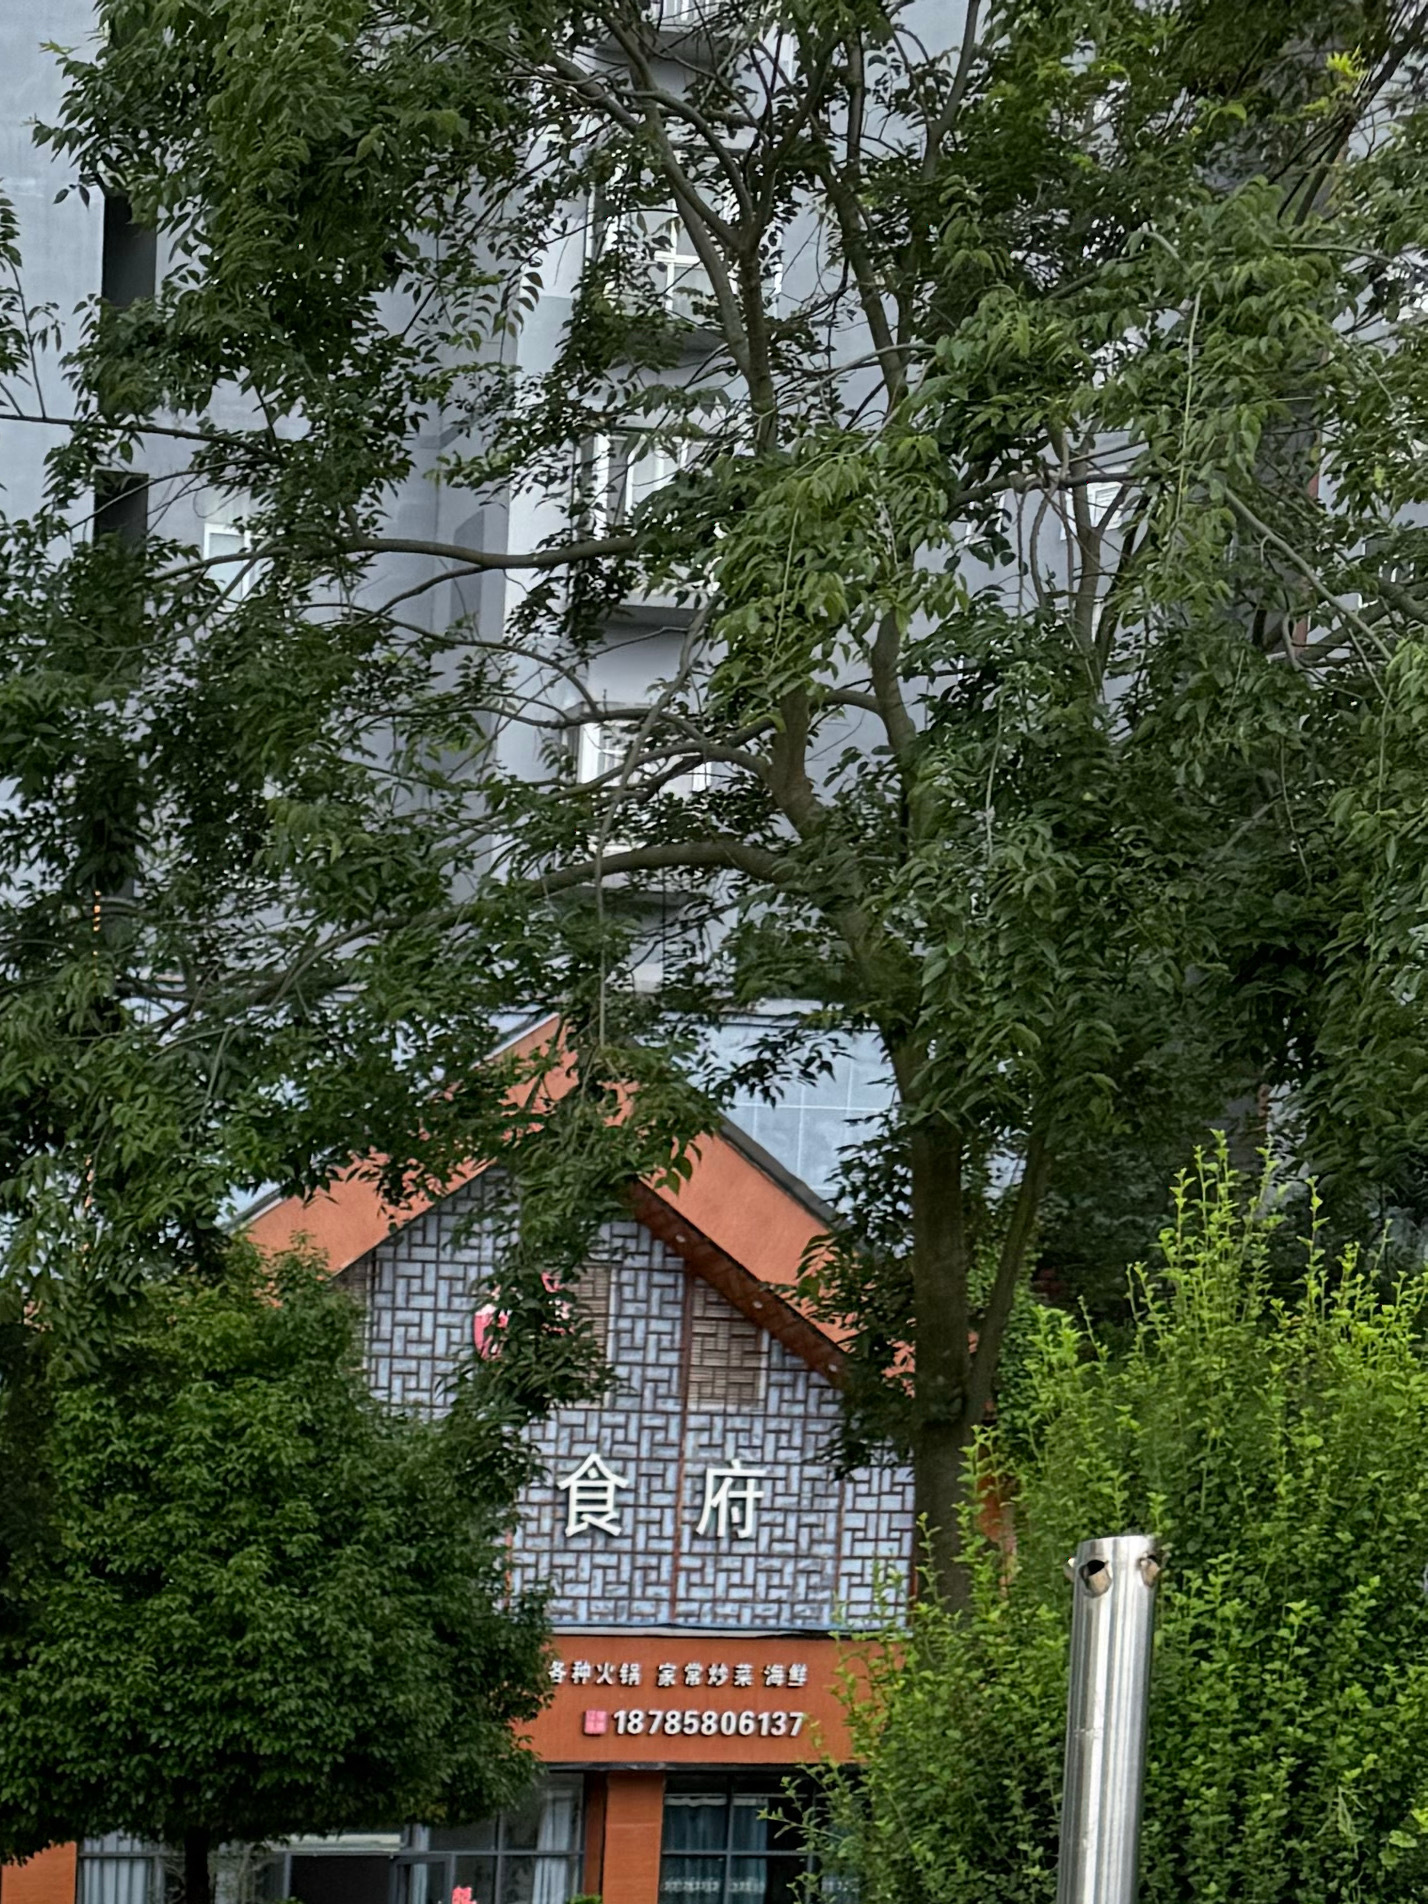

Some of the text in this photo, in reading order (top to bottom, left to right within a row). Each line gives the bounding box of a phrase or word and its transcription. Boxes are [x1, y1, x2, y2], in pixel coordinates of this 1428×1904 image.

[548, 1660, 808, 1687] 各种火锅 家常炒菜 海鲜
[613, 1709, 805, 1737] 18785806137
